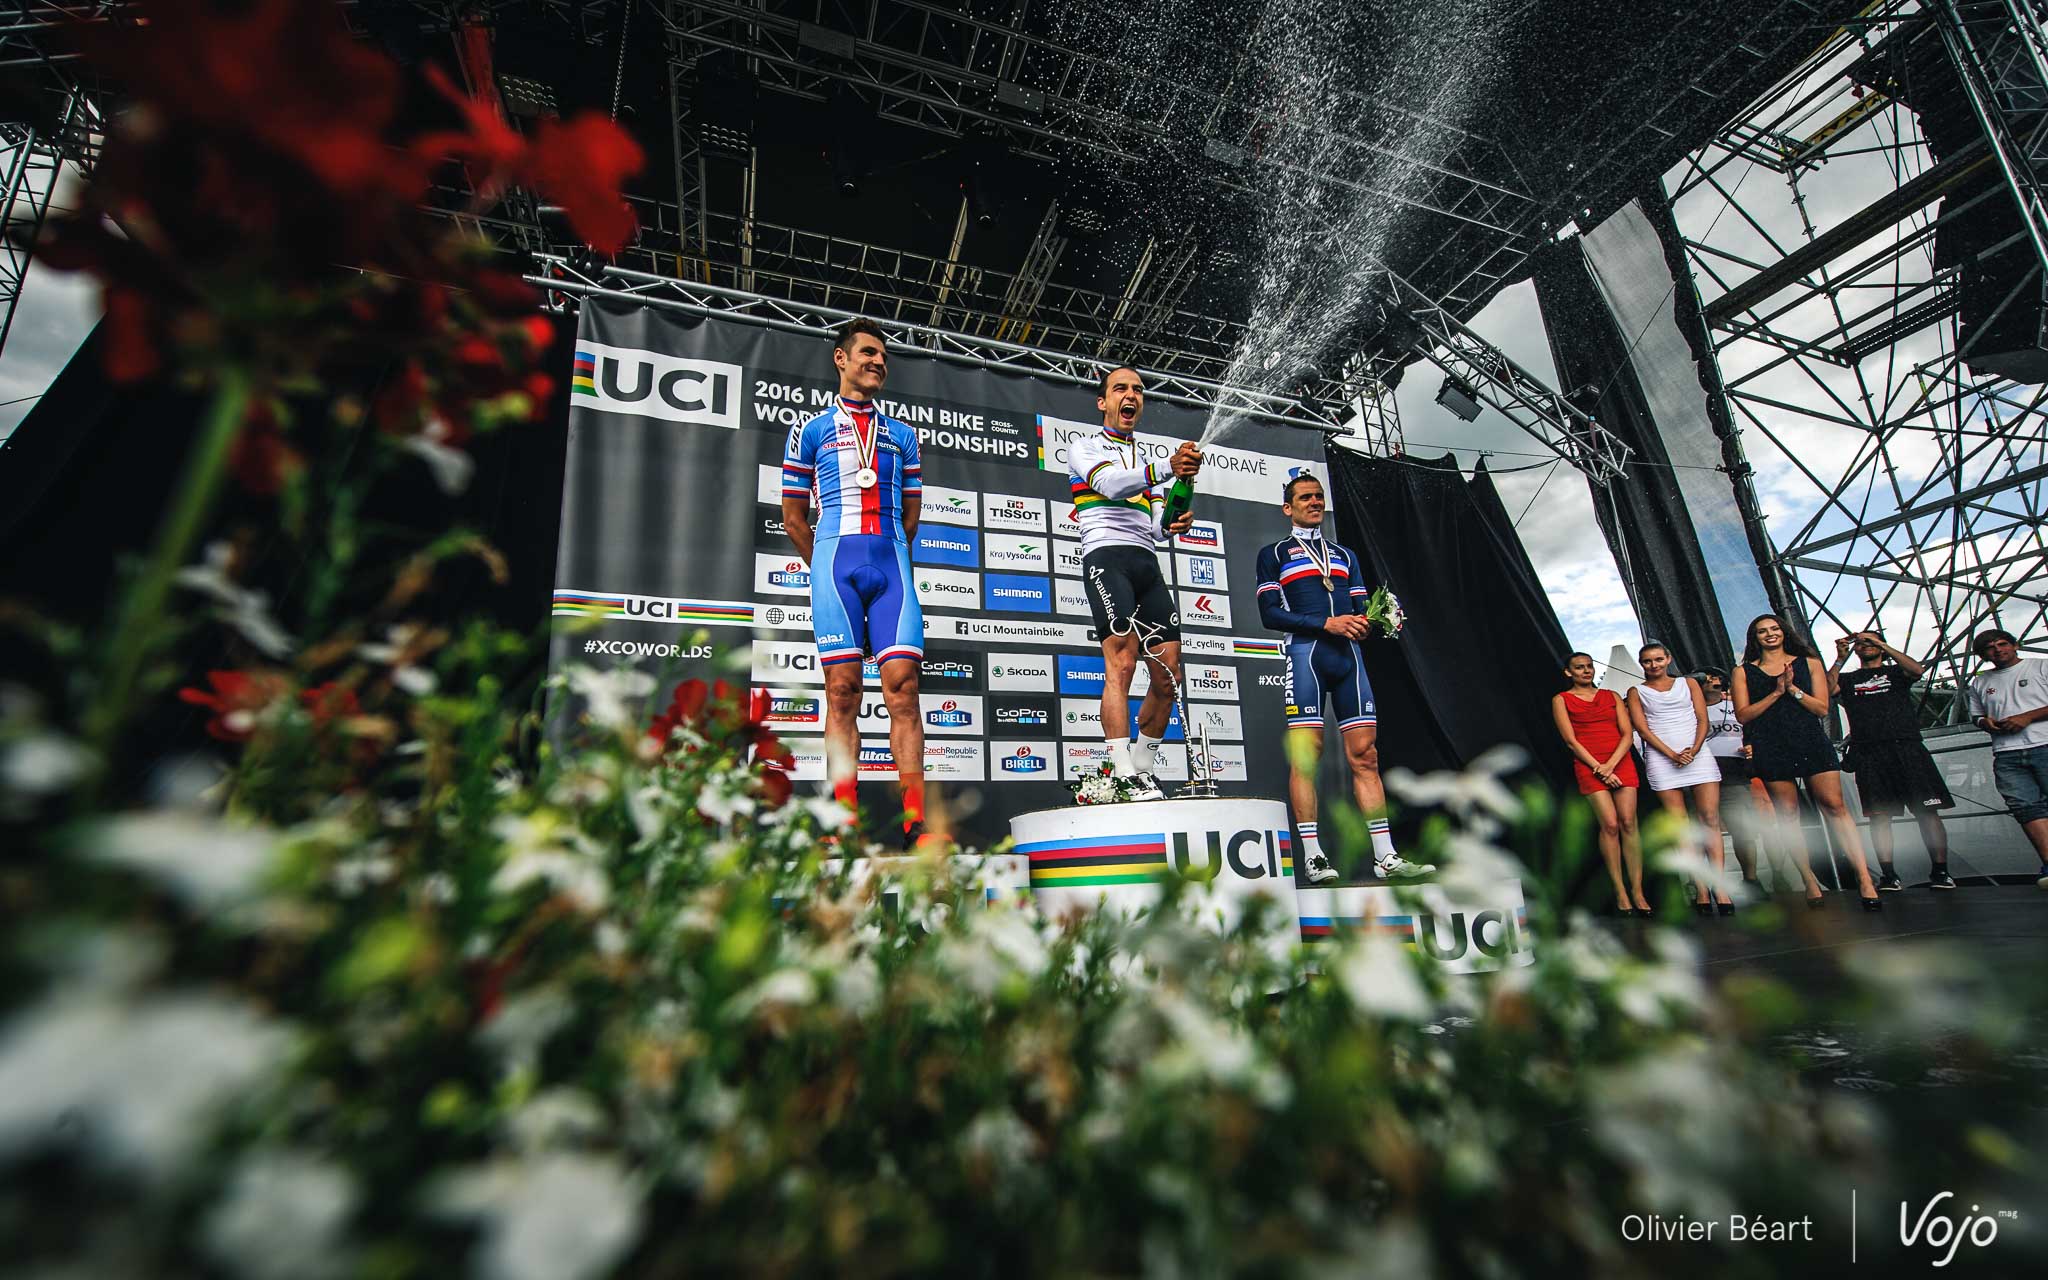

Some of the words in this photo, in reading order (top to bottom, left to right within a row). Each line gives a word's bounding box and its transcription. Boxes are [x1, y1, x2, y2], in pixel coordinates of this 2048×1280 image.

[601, 356, 729, 415] UCI
[755, 380, 805, 404] 2016
[811, 388, 934, 425] MNTAIN
[940, 407, 984, 432] BIKE
[991, 426, 1019, 436] COUNTRY
[913, 427, 1029, 459] PIONSHIPS
[1137, 441, 1169, 459] STO
[1202, 453, 1268, 477] MORAVĚ
[989, 508, 1041, 521] TISSOT
[920, 539, 971, 552] SHIMANO
[989, 550, 1005, 561] Kraj
[1059, 554, 1084, 566] TIS
[1192, 558, 1214, 579] SMS
[934, 583, 975, 595] ŠKODA
[993, 588, 1043, 599] SHIMANO
[1060, 595, 1075, 606] Kraj
[1095, 577, 1115, 621] vaudoise
[626, 600, 673, 619] UCI
[1186, 612, 1226, 622] KROSS
[973, 624, 991, 634] UCI
[994, 626, 1064, 637] Mountainbike
[921, 661, 973, 672] GoPro
[1007, 667, 1048, 677] ŠKODA
[1067, 671, 1106, 681] SHIMAN
[1190, 678, 1233, 690] TISSOT
[857, 703, 890, 719] UC
[996, 708, 1048, 718] GoPro
[930, 713, 968, 724] BIRELL
[1080, 712, 1101, 723] ŠKO
[1005, 759, 1043, 769] BIRELL
[1172, 828, 1279, 882] UCI
